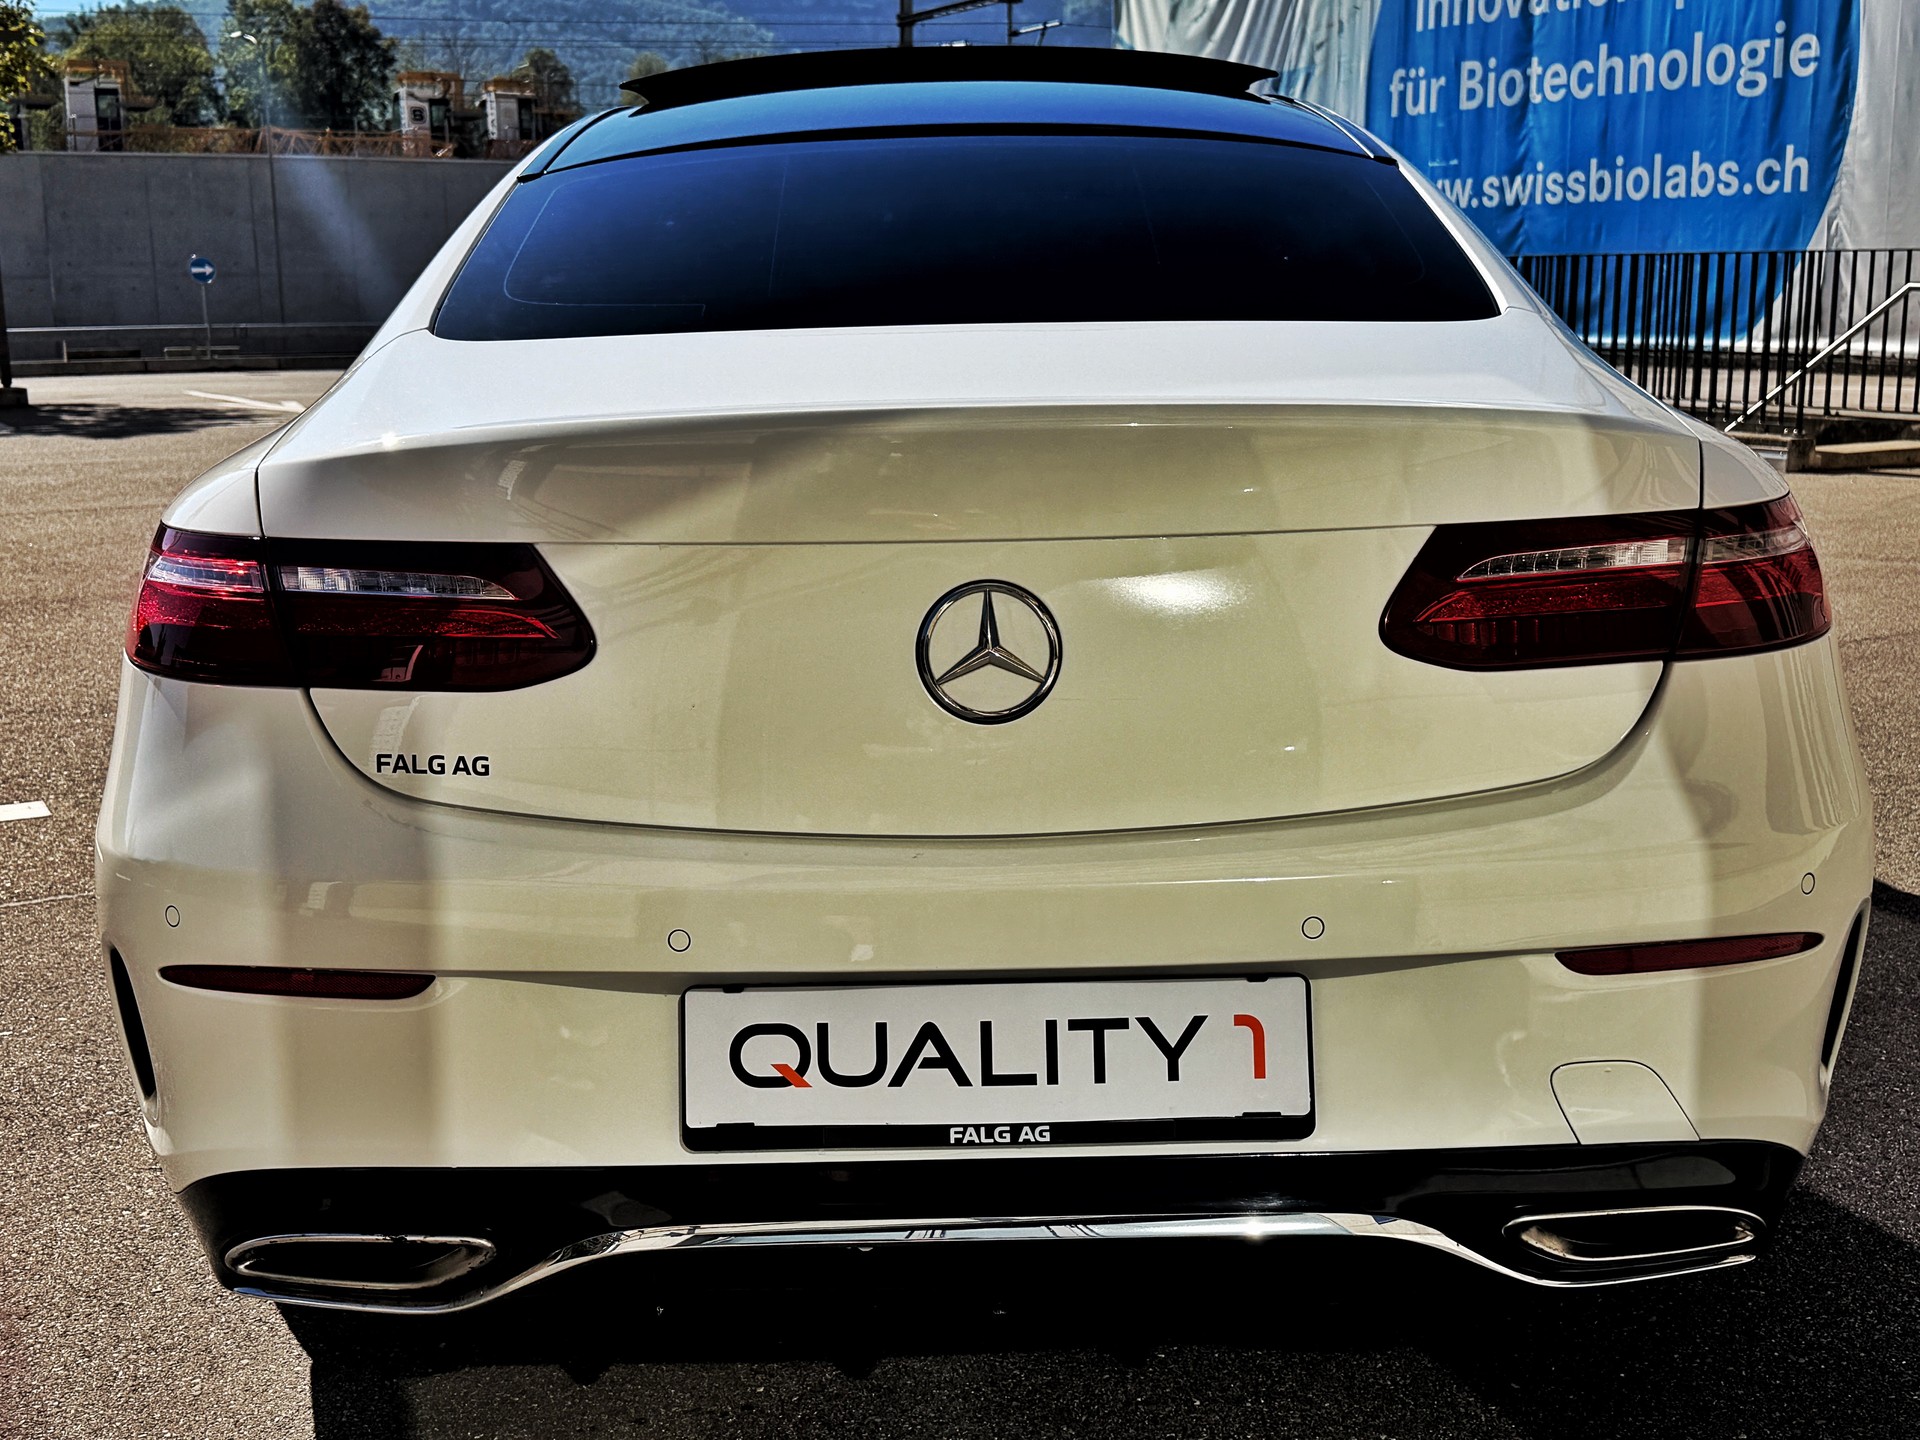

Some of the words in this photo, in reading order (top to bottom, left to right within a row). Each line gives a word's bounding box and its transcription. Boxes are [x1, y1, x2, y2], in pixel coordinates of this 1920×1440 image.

[1389, 67, 1446, 118] für
[1459, 20, 1820, 110] Biotechnologie
[1436, 145, 1808, 208] w.swissbiolabs.ch
[376, 753, 446, 775] FALG
[451, 755, 490, 776] AG
[729, 1014, 1209, 1088] QUALITY
[949, 1126, 1011, 1144] FALG
[1018, 1125, 1051, 1143] AG
